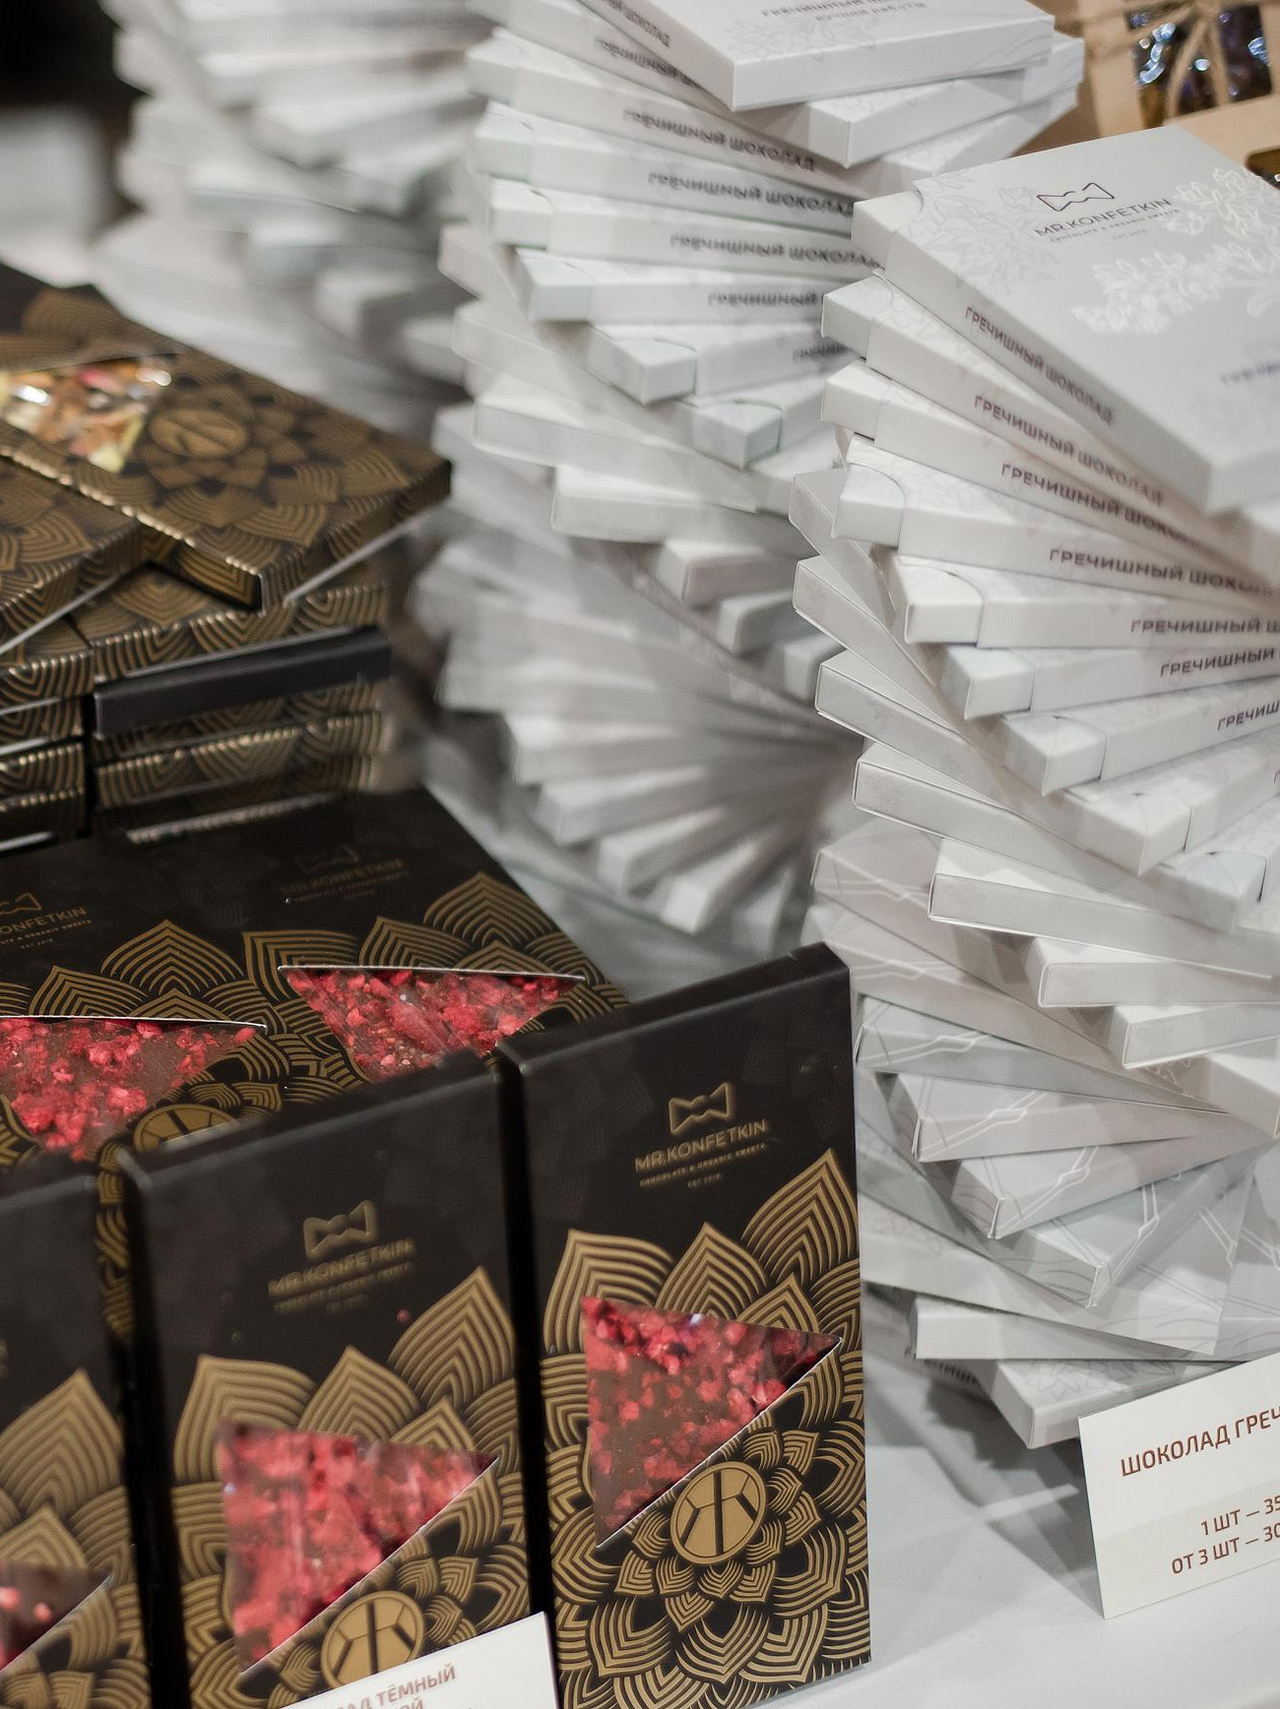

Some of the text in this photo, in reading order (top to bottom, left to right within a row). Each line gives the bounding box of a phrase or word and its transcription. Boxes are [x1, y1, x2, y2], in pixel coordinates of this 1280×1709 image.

[965, 306, 1044, 371] ГРЕЧИШНЫЙ
[975, 395, 1075, 457] ГРЕЧИШНЫЙ
[1001, 463, 1122, 516] ГРЕЧИШНЫЙ
[1050, 548, 1183, 582] ГРЕЧИШНЫЙ
[1131, 617, 1261, 634] ГРЕЧИШНЫЙ
[635, 1118, 767, 1172] MR.KONFETKIN
[1120, 1425, 1231, 1477] ШОКОЛАД
[1200, 1520, 1209, 1536] 1
[1213, 1508, 1241, 1533] ШТ
[1171, 1552, 1194, 1574] ОТ
[1198, 1548, 1209, 1566] 3
[1212, 1536, 1240, 1561] ШТ
[376, 1662, 458, 1706] ТЁМНЫЙ
